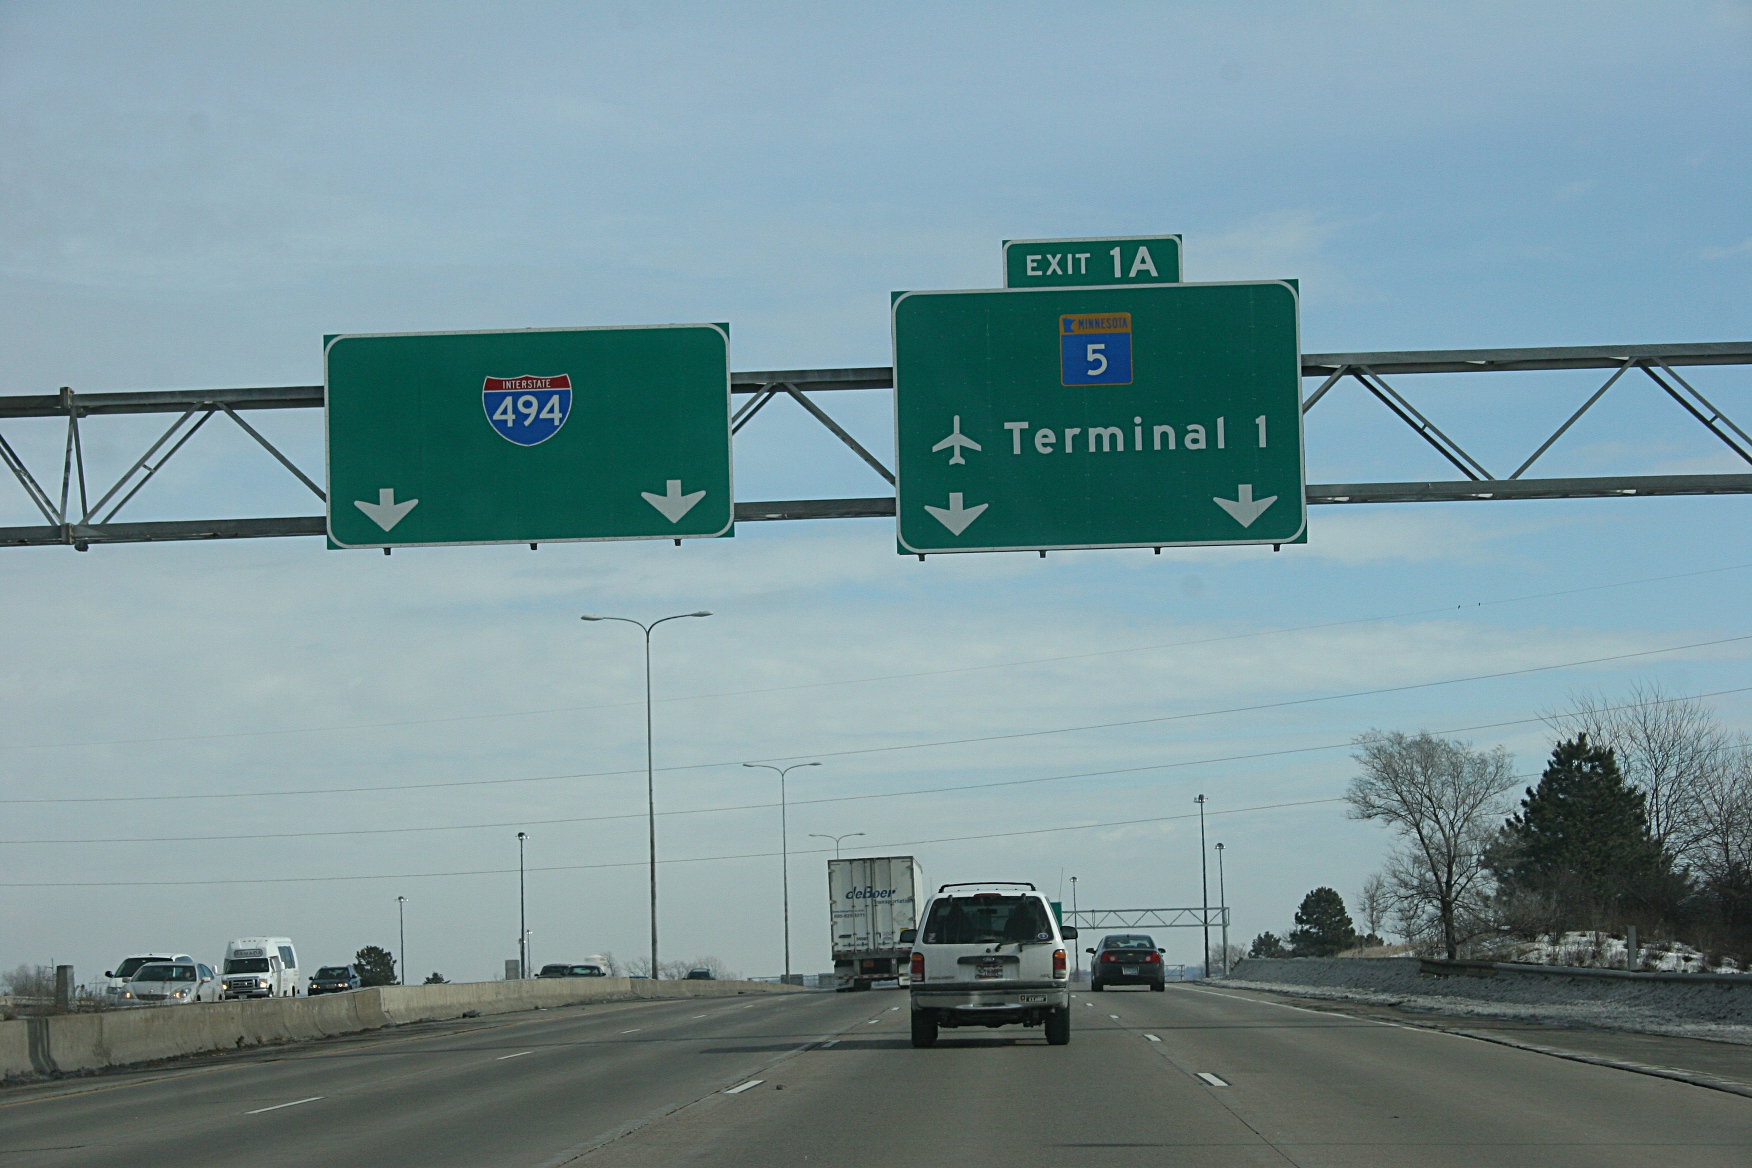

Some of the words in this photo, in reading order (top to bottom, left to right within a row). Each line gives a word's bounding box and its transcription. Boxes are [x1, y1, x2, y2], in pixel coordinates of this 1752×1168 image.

[1026, 253, 1091, 276] EXIT
[1110, 246, 1159, 278] 1A
[1078, 317, 1128, 330] MINNESOTA
[1087, 343, 1108, 376] 5
[502, 379, 551, 389] INTERSTATE
[493, 394, 563, 428] 494
[1003, 416, 1225, 455] Terminal
[1255, 415, 1267, 449] 1
[846, 886, 896, 899] deBoer
